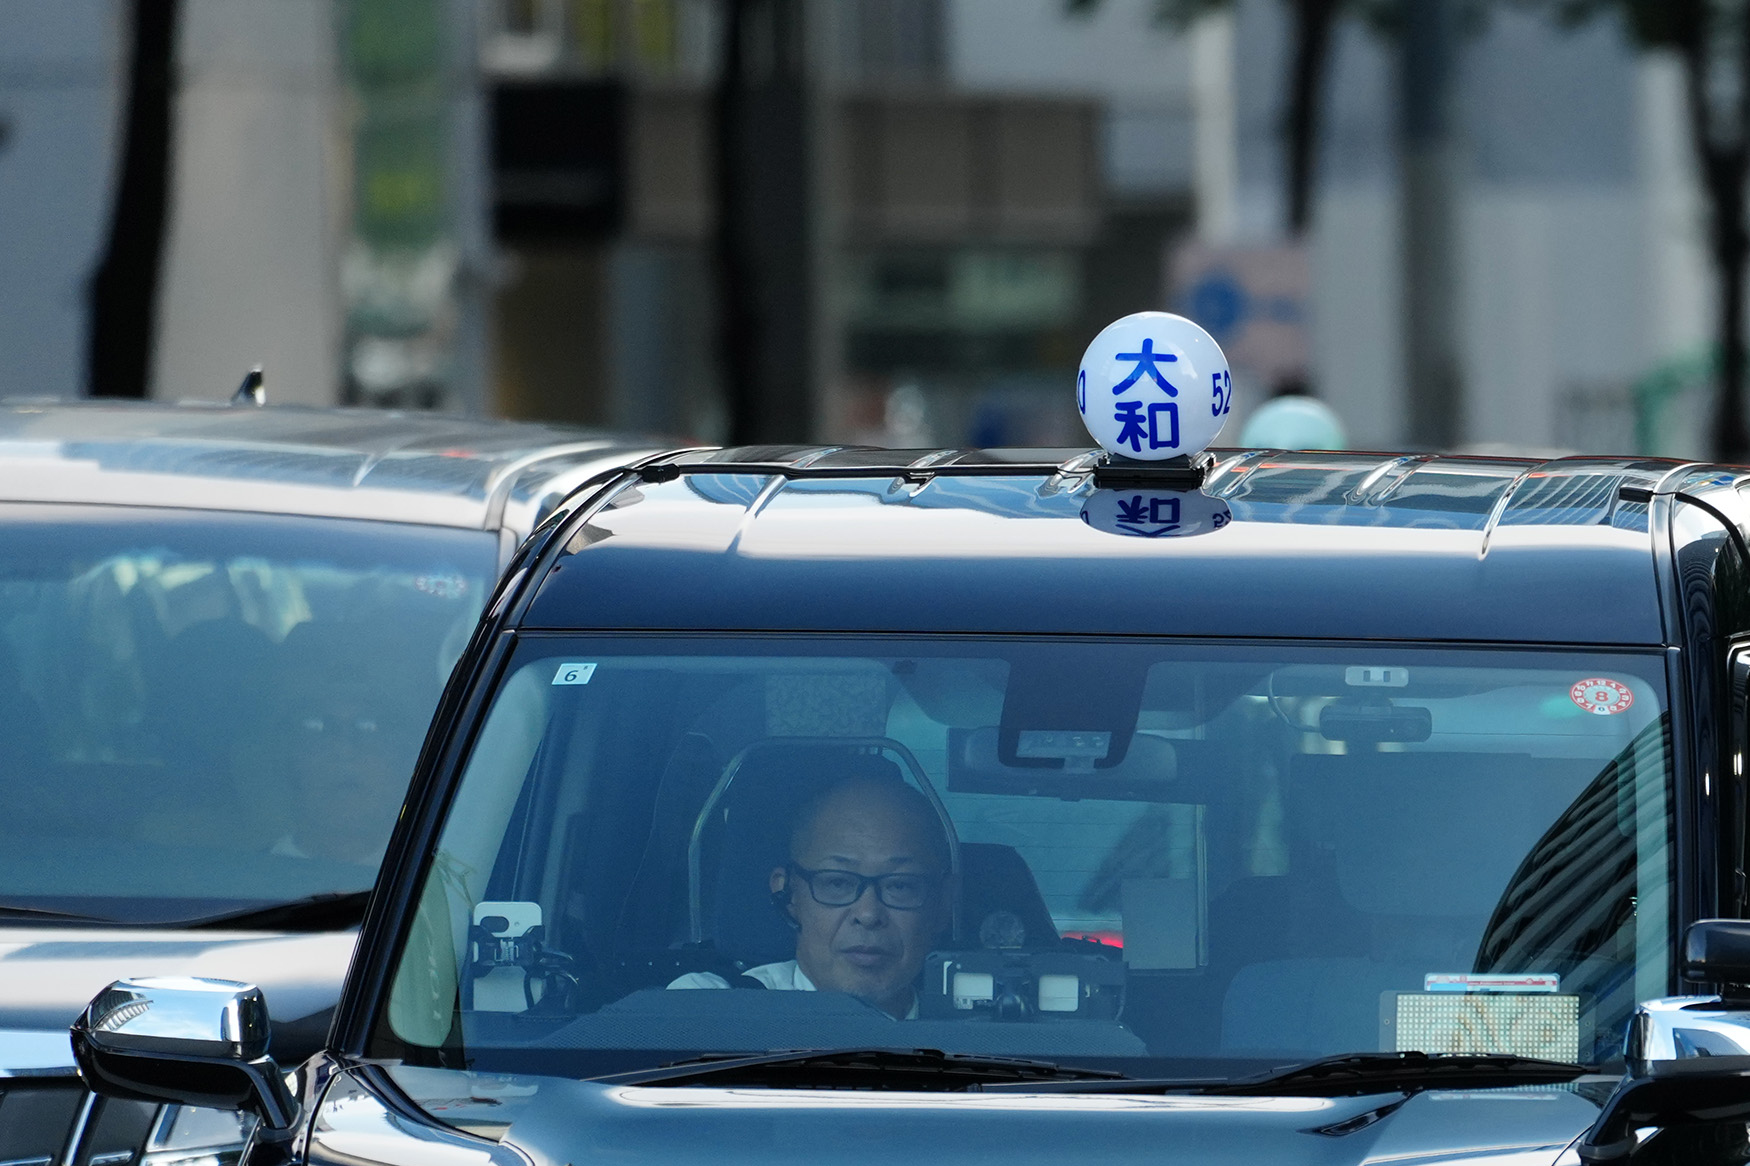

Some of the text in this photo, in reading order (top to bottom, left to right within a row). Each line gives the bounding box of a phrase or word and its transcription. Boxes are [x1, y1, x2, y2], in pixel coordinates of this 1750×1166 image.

[1112, 338, 1180, 452] 大和
[565, 670, 579, 682] 6
[1595, 691, 1609, 702] 8
